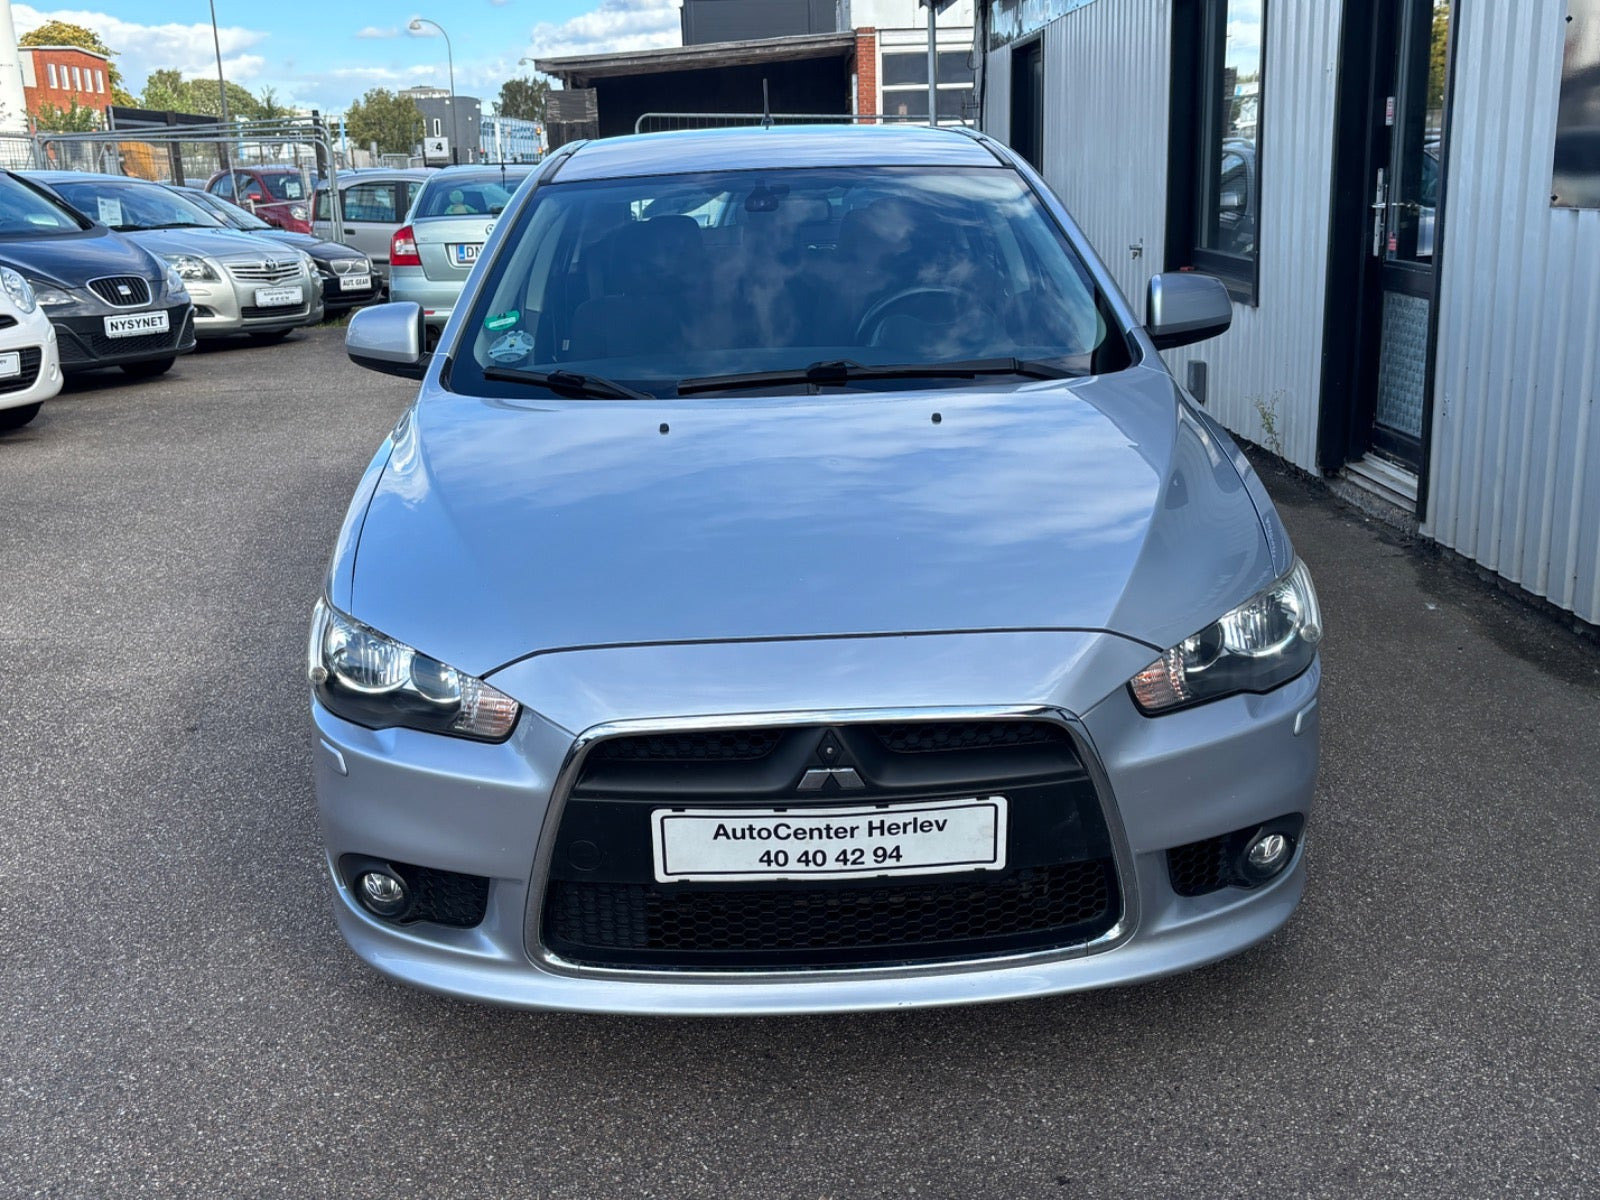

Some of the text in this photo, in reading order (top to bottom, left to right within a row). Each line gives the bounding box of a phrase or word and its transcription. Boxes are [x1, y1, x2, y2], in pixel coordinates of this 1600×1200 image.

[435, 142, 443, 151] 4
[110, 315, 164, 331] NYSYNET
[713, 817, 949, 841] AutoCenter Herlev
[758, 845, 903, 867] 40 40 42 94
